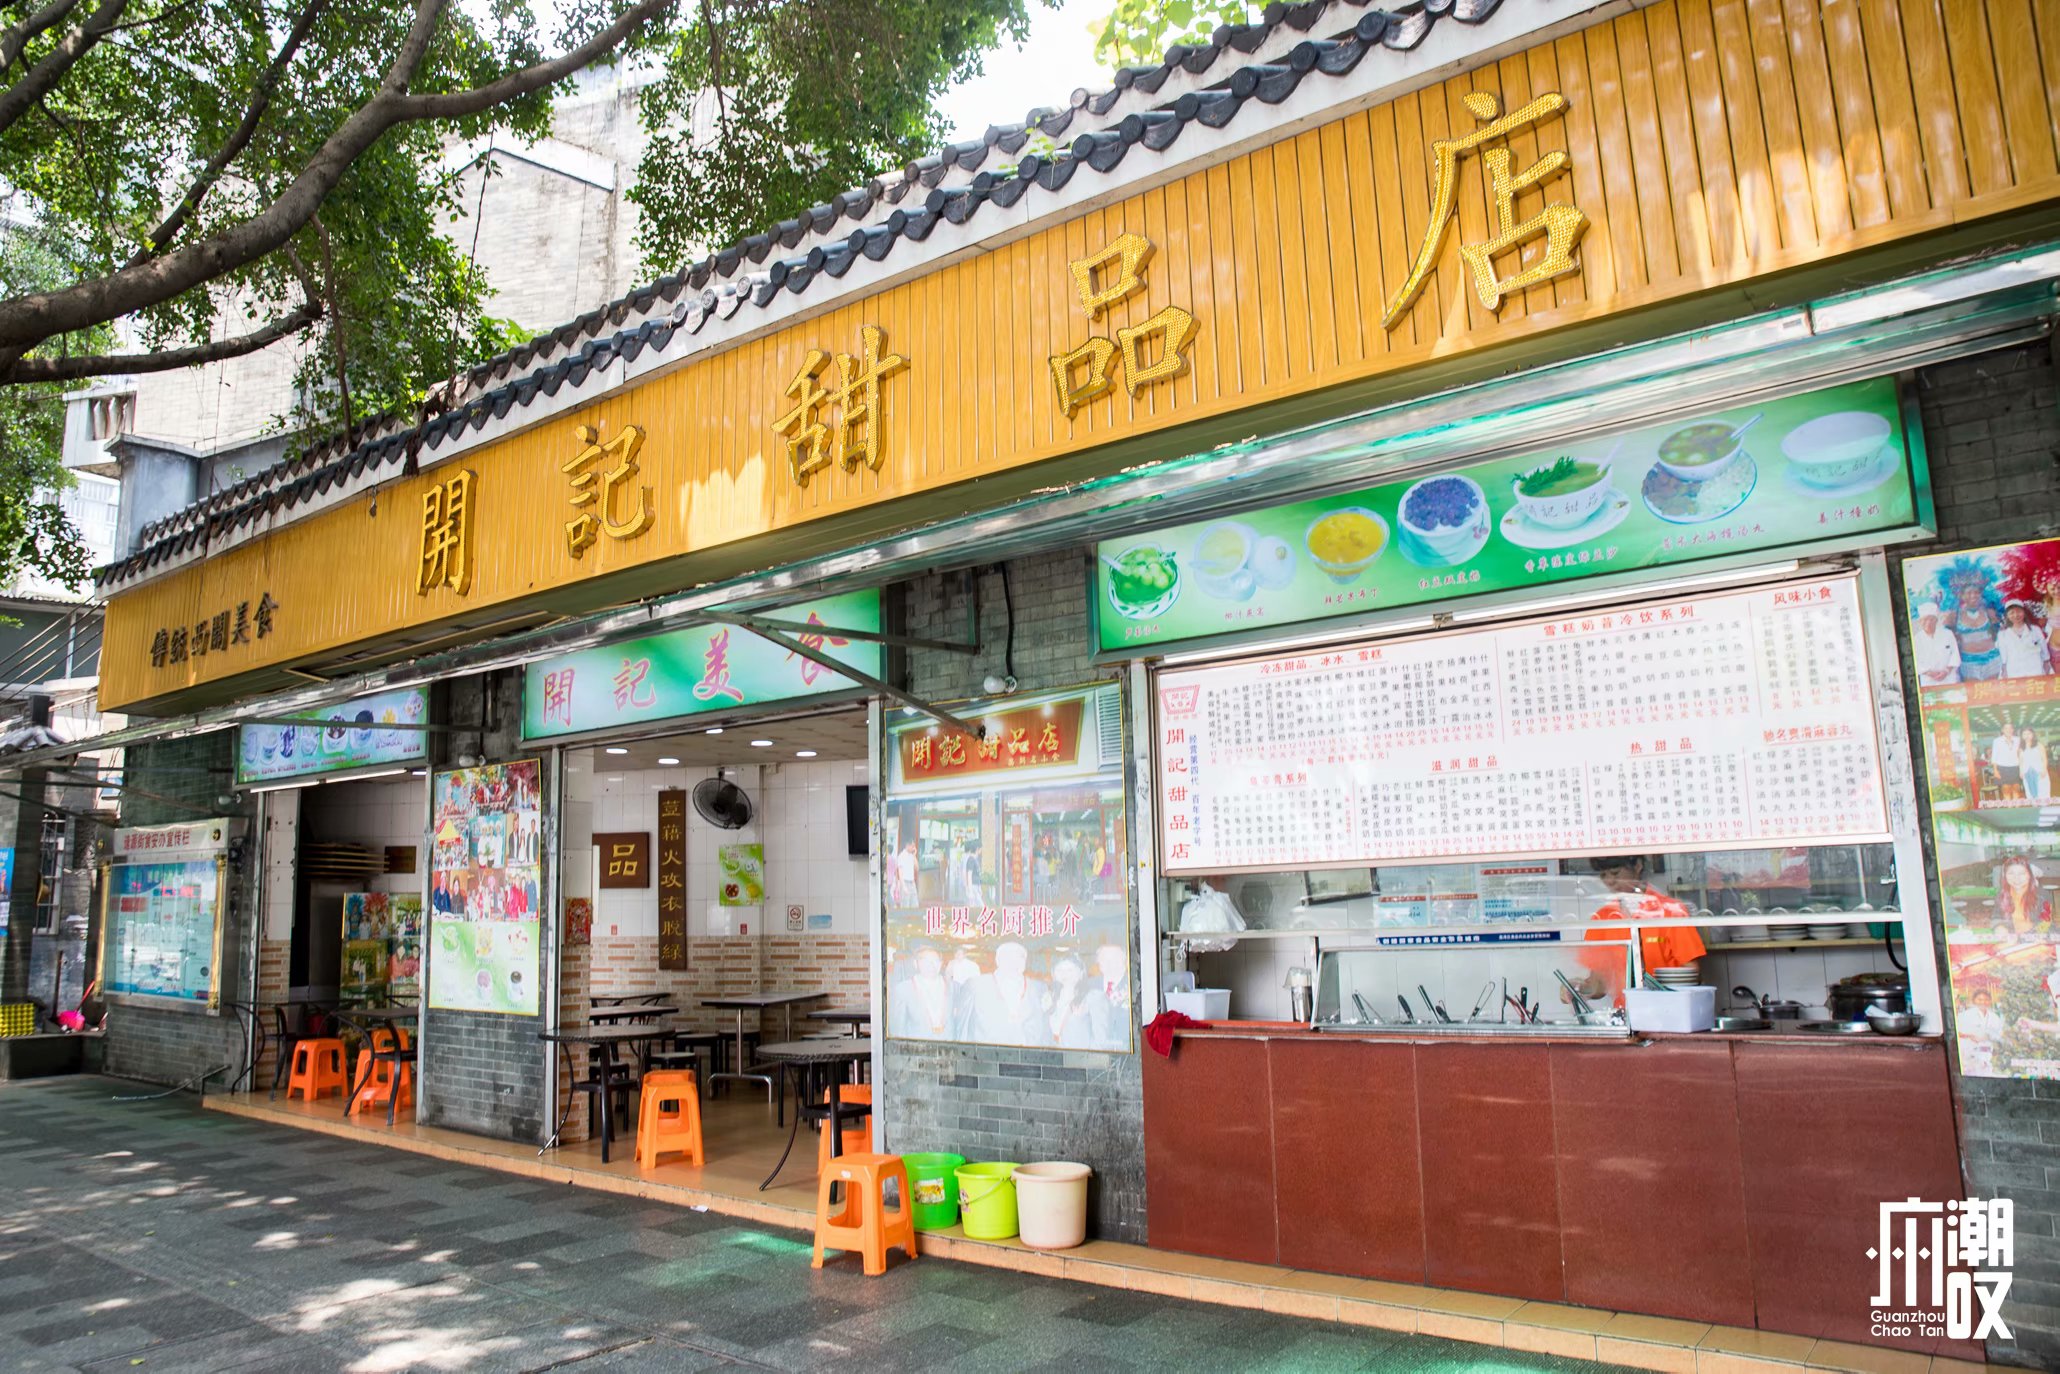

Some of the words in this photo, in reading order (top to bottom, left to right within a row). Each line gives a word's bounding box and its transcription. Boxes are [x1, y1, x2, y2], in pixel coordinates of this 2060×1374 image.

[417, 91, 1588, 596] 開記甜品店
[1774, 586, 1832, 605] 风味小食
[150, 591, 279, 668] 傳統西關美食
[1543, 605, 1695, 637] 雪糕奶昔冷饮系列
[543, 611, 849, 728] 開記美食
[911, 721, 1061, 771] 開記甜品店
[1431, 752, 1497, 771] 滋润甜品
[1631, 737, 1692, 755] 热甜品
[1166, 728, 1190, 859] 開記甜品店
[608, 843, 638, 876] 品
[925, 904, 1083, 936] 世界名厨推介
